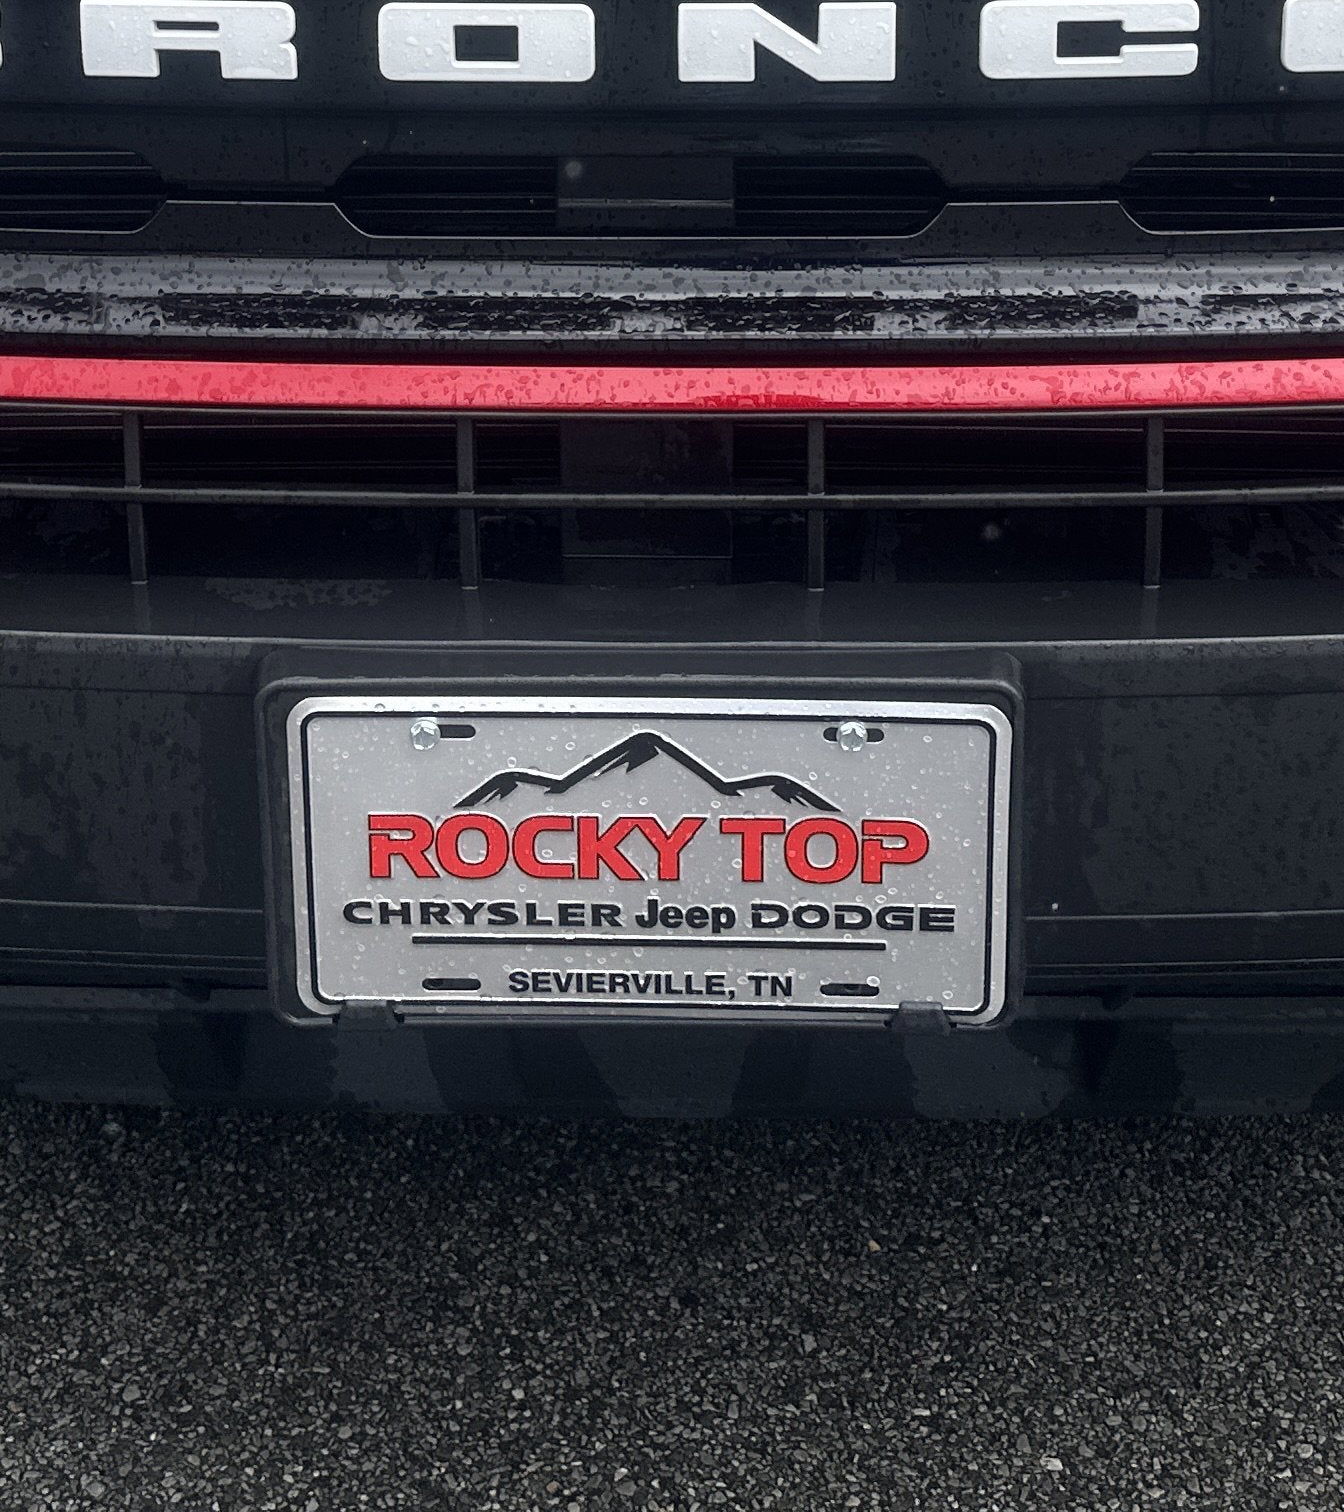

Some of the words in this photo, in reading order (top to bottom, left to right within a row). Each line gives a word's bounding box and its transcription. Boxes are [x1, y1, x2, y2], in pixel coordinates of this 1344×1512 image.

[367, 813, 706, 882] ROCKY
[722, 816, 931, 884] TOP
[342, 899, 622, 929] CHRYSLER
[635, 900, 736, 934] Jeep
[750, 901, 956, 933] DODGE
[508, 970, 736, 1000] SEVIERVILLE,
[750, 973, 793, 998] TN
